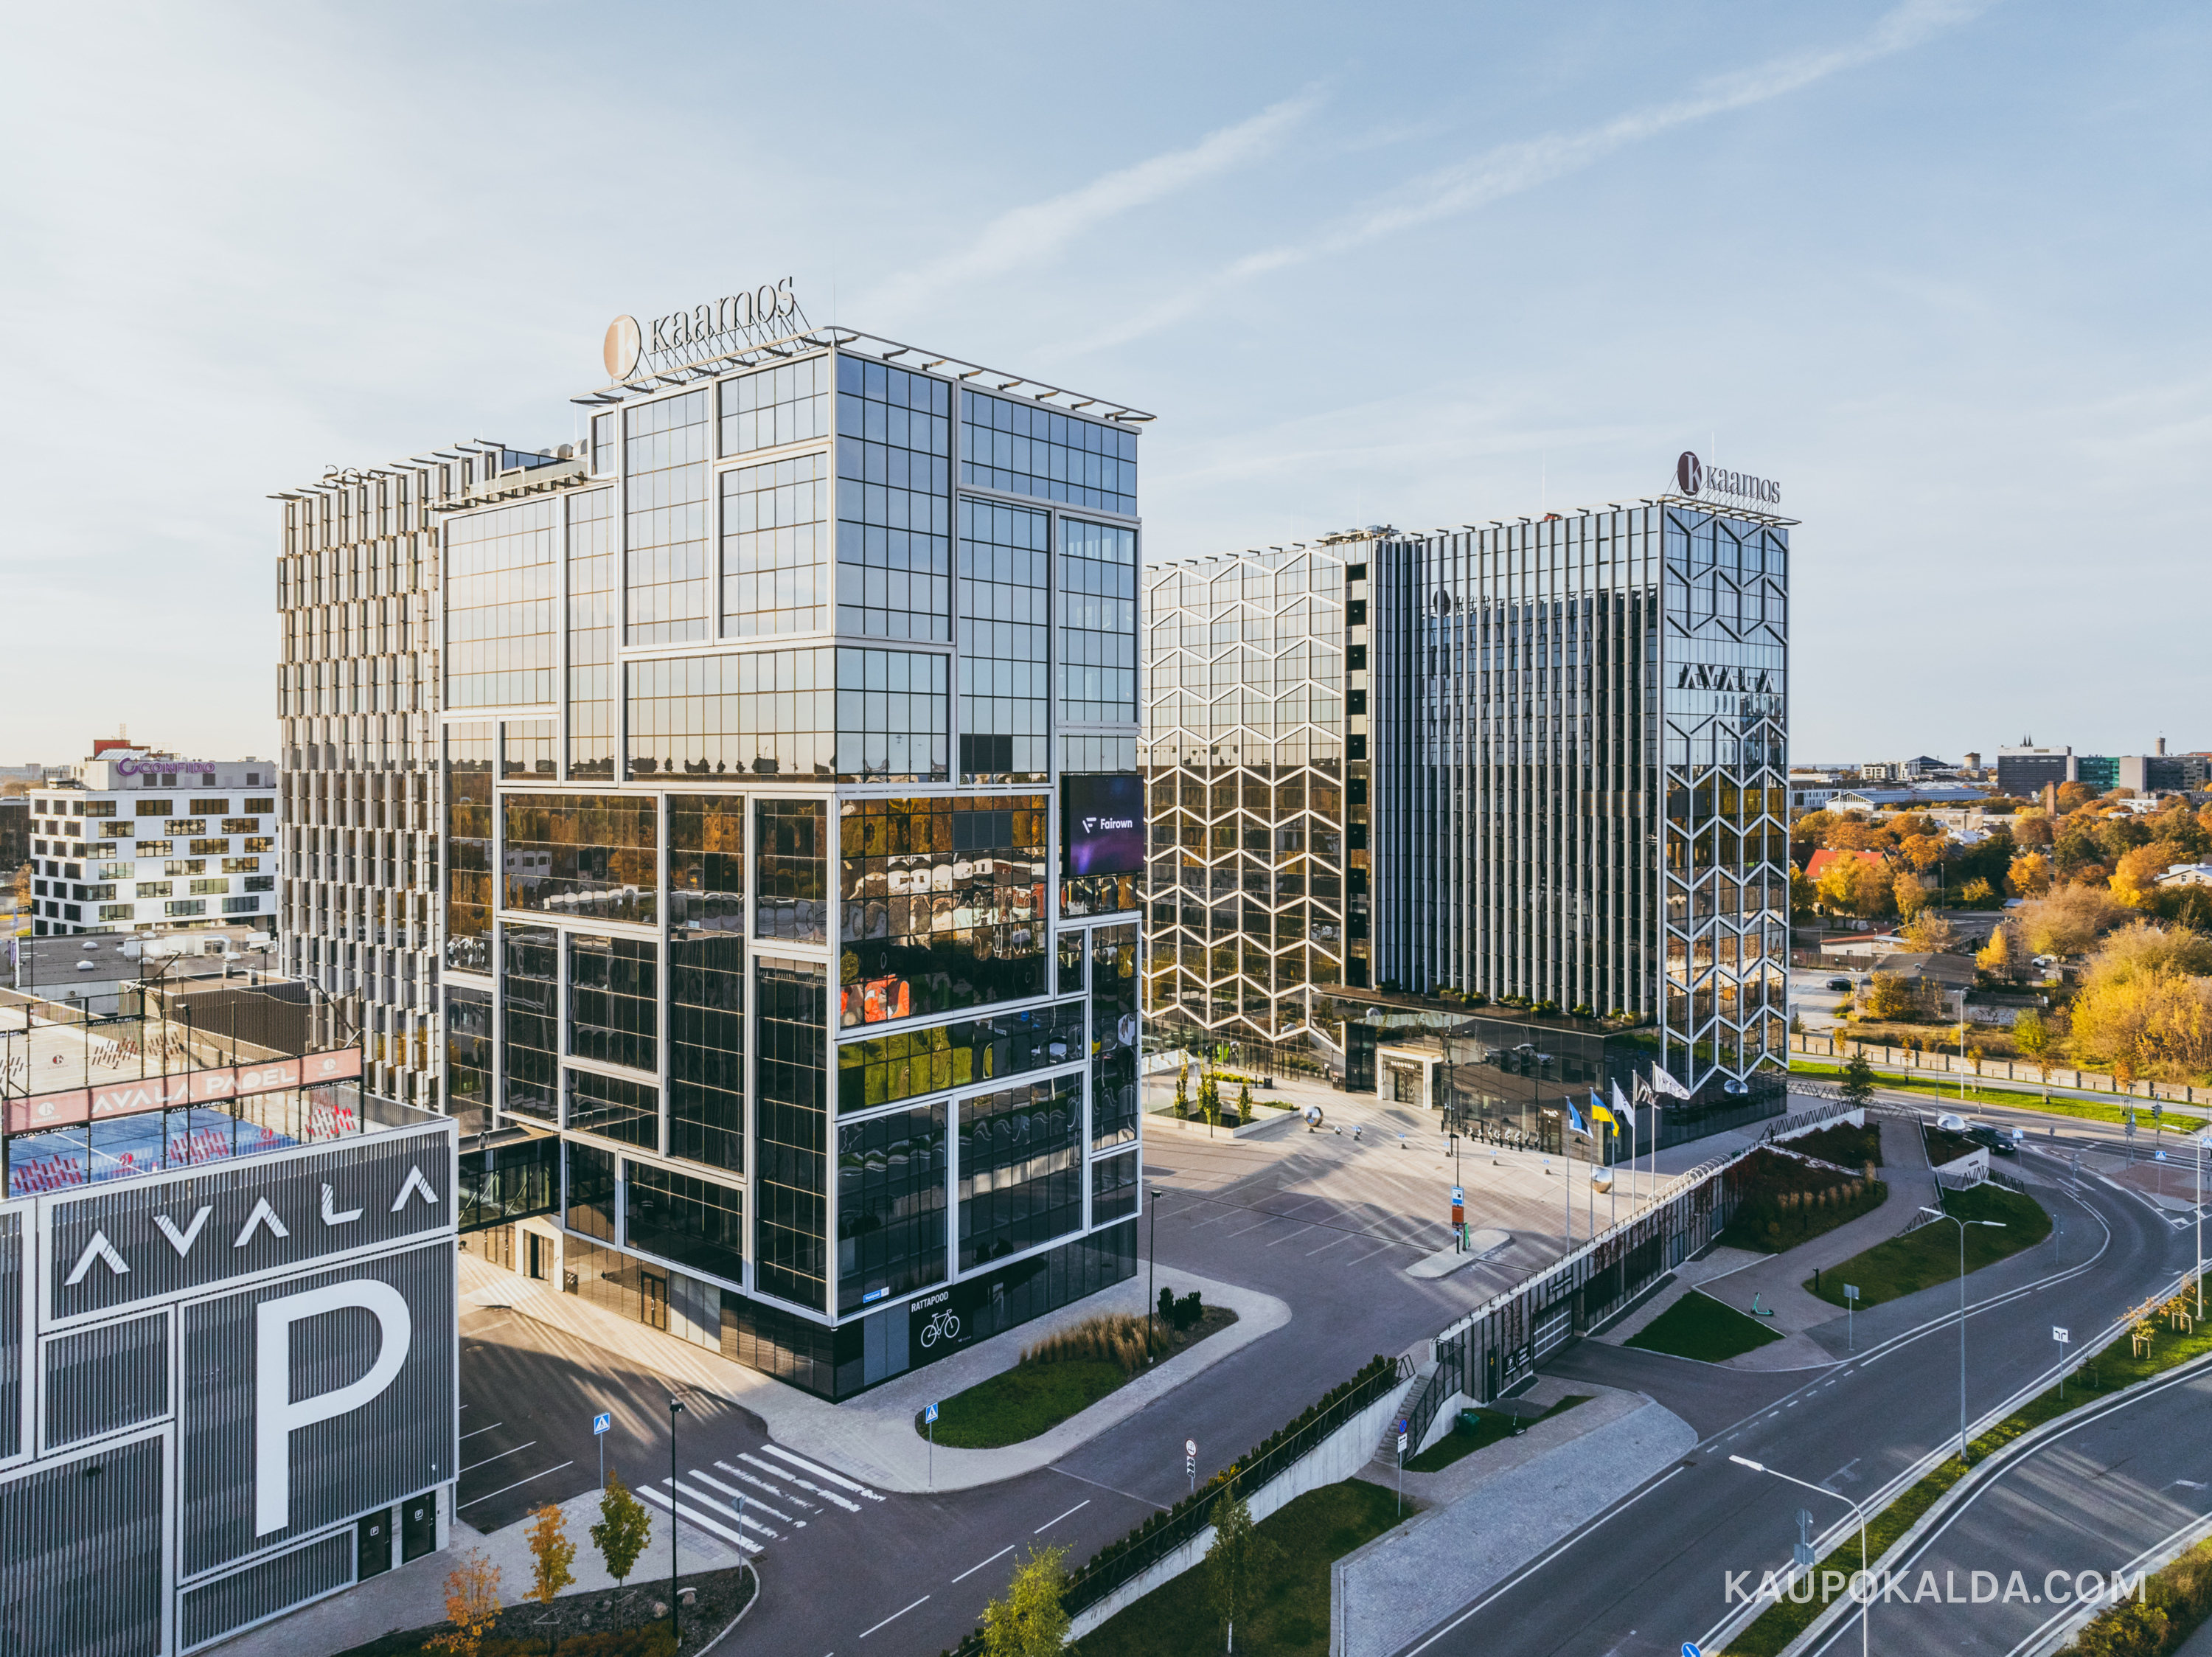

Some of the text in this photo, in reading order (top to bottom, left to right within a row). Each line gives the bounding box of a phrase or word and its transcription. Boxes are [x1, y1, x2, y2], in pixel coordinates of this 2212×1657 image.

[1677, 664, 1775, 693] AVALA
[139, 763, 216, 774] CONFIDO
[1100, 817, 1133, 830] Fairown
[91, 1066, 298, 1114] AVALA PADEL
[171, 1105, 199, 1114] AVAA
[64, 1164, 439, 1287] AVALA
[911, 1291, 949, 1313] RATTAPOOD
[256, 1279, 411, 1538] P
